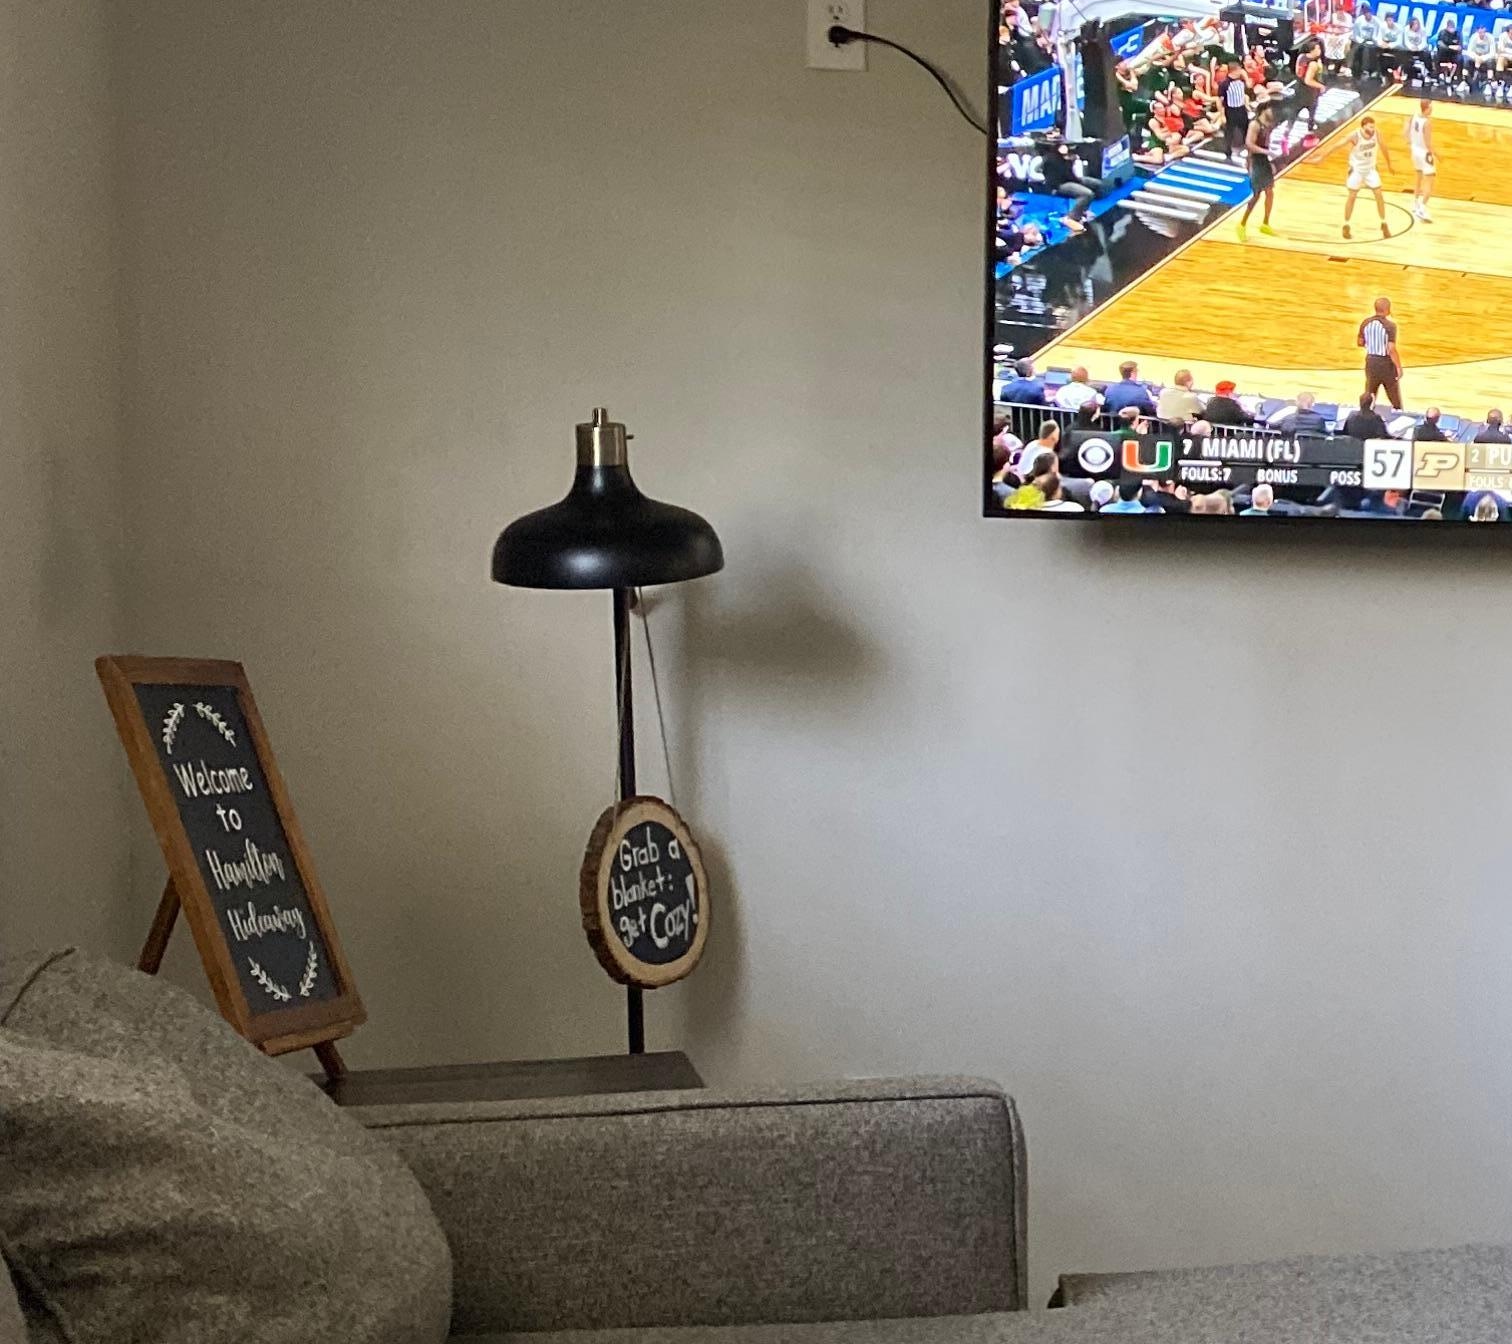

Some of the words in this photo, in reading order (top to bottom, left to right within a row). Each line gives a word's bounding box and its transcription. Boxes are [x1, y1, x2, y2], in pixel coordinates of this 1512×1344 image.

[1182, 439, 1193, 455] 7
[1201, 438, 1264, 459] MIAMI
[1266, 439, 1301, 463] (FL)
[1371, 449, 1405, 478] 57
[1471, 449, 1480, 463] 2
[1257, 469, 1298, 484] BONUS
[1329, 470, 1362, 485] POSS
[173, 759, 254, 799] Welcome
[215, 802, 243, 833] to
[205, 838, 286, 891] Hamilton
[619, 826, 660, 873] Grab
[667, 838, 681, 861] a
[226, 900, 307, 941] Hideaway
[619, 907, 647, 949] get
